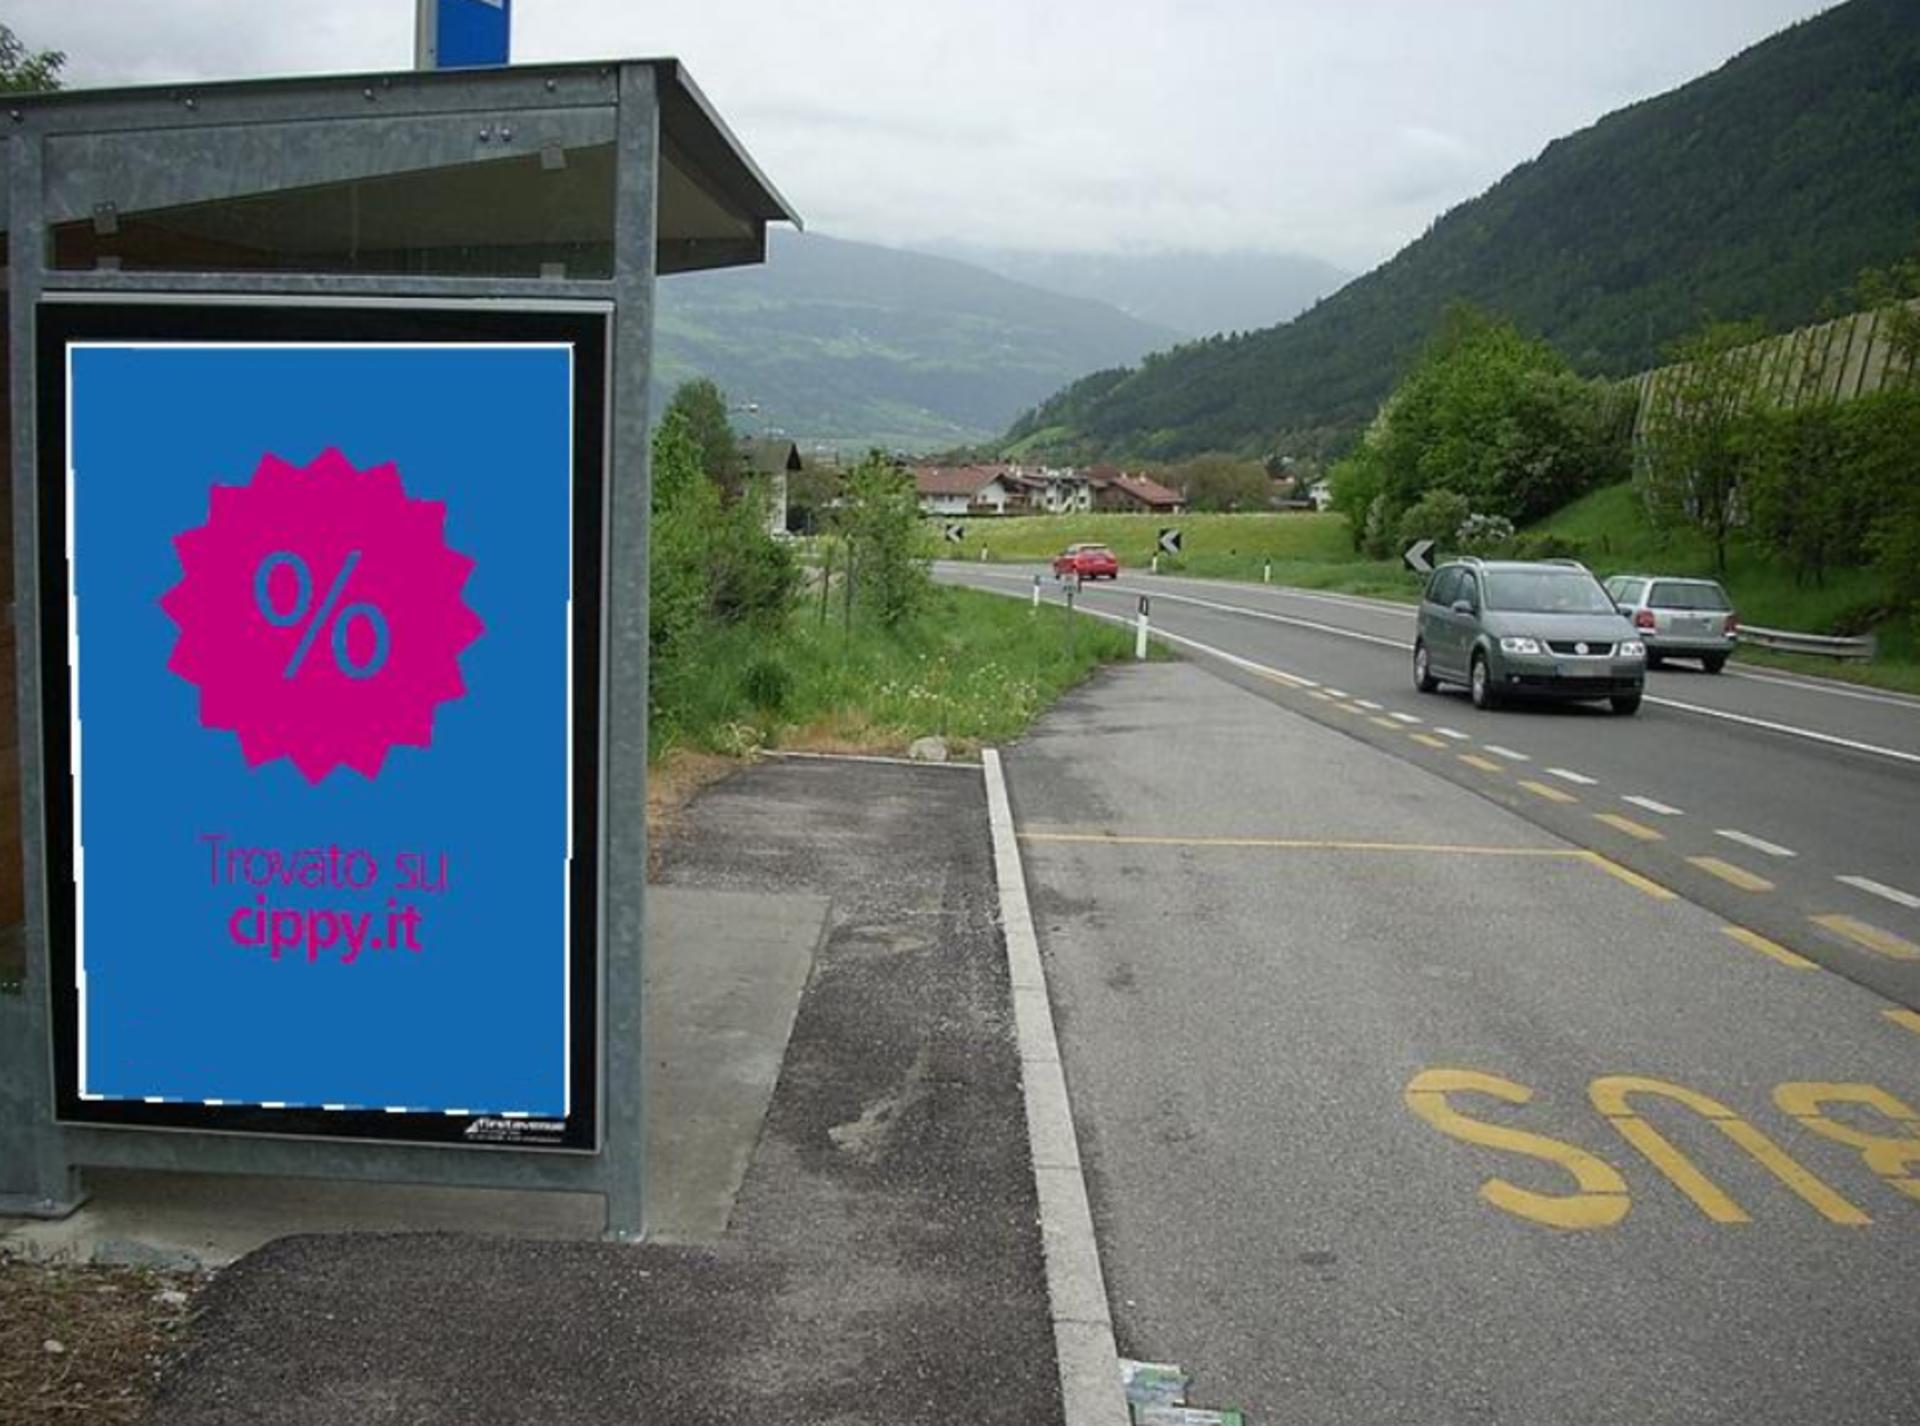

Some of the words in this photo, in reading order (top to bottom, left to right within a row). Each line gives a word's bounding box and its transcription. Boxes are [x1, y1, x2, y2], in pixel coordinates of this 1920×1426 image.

[254, 550, 390, 680] %
[199, 833, 378, 889] Trovato
[395, 851, 448, 892] su
[228, 892, 422, 965] cippy.it
